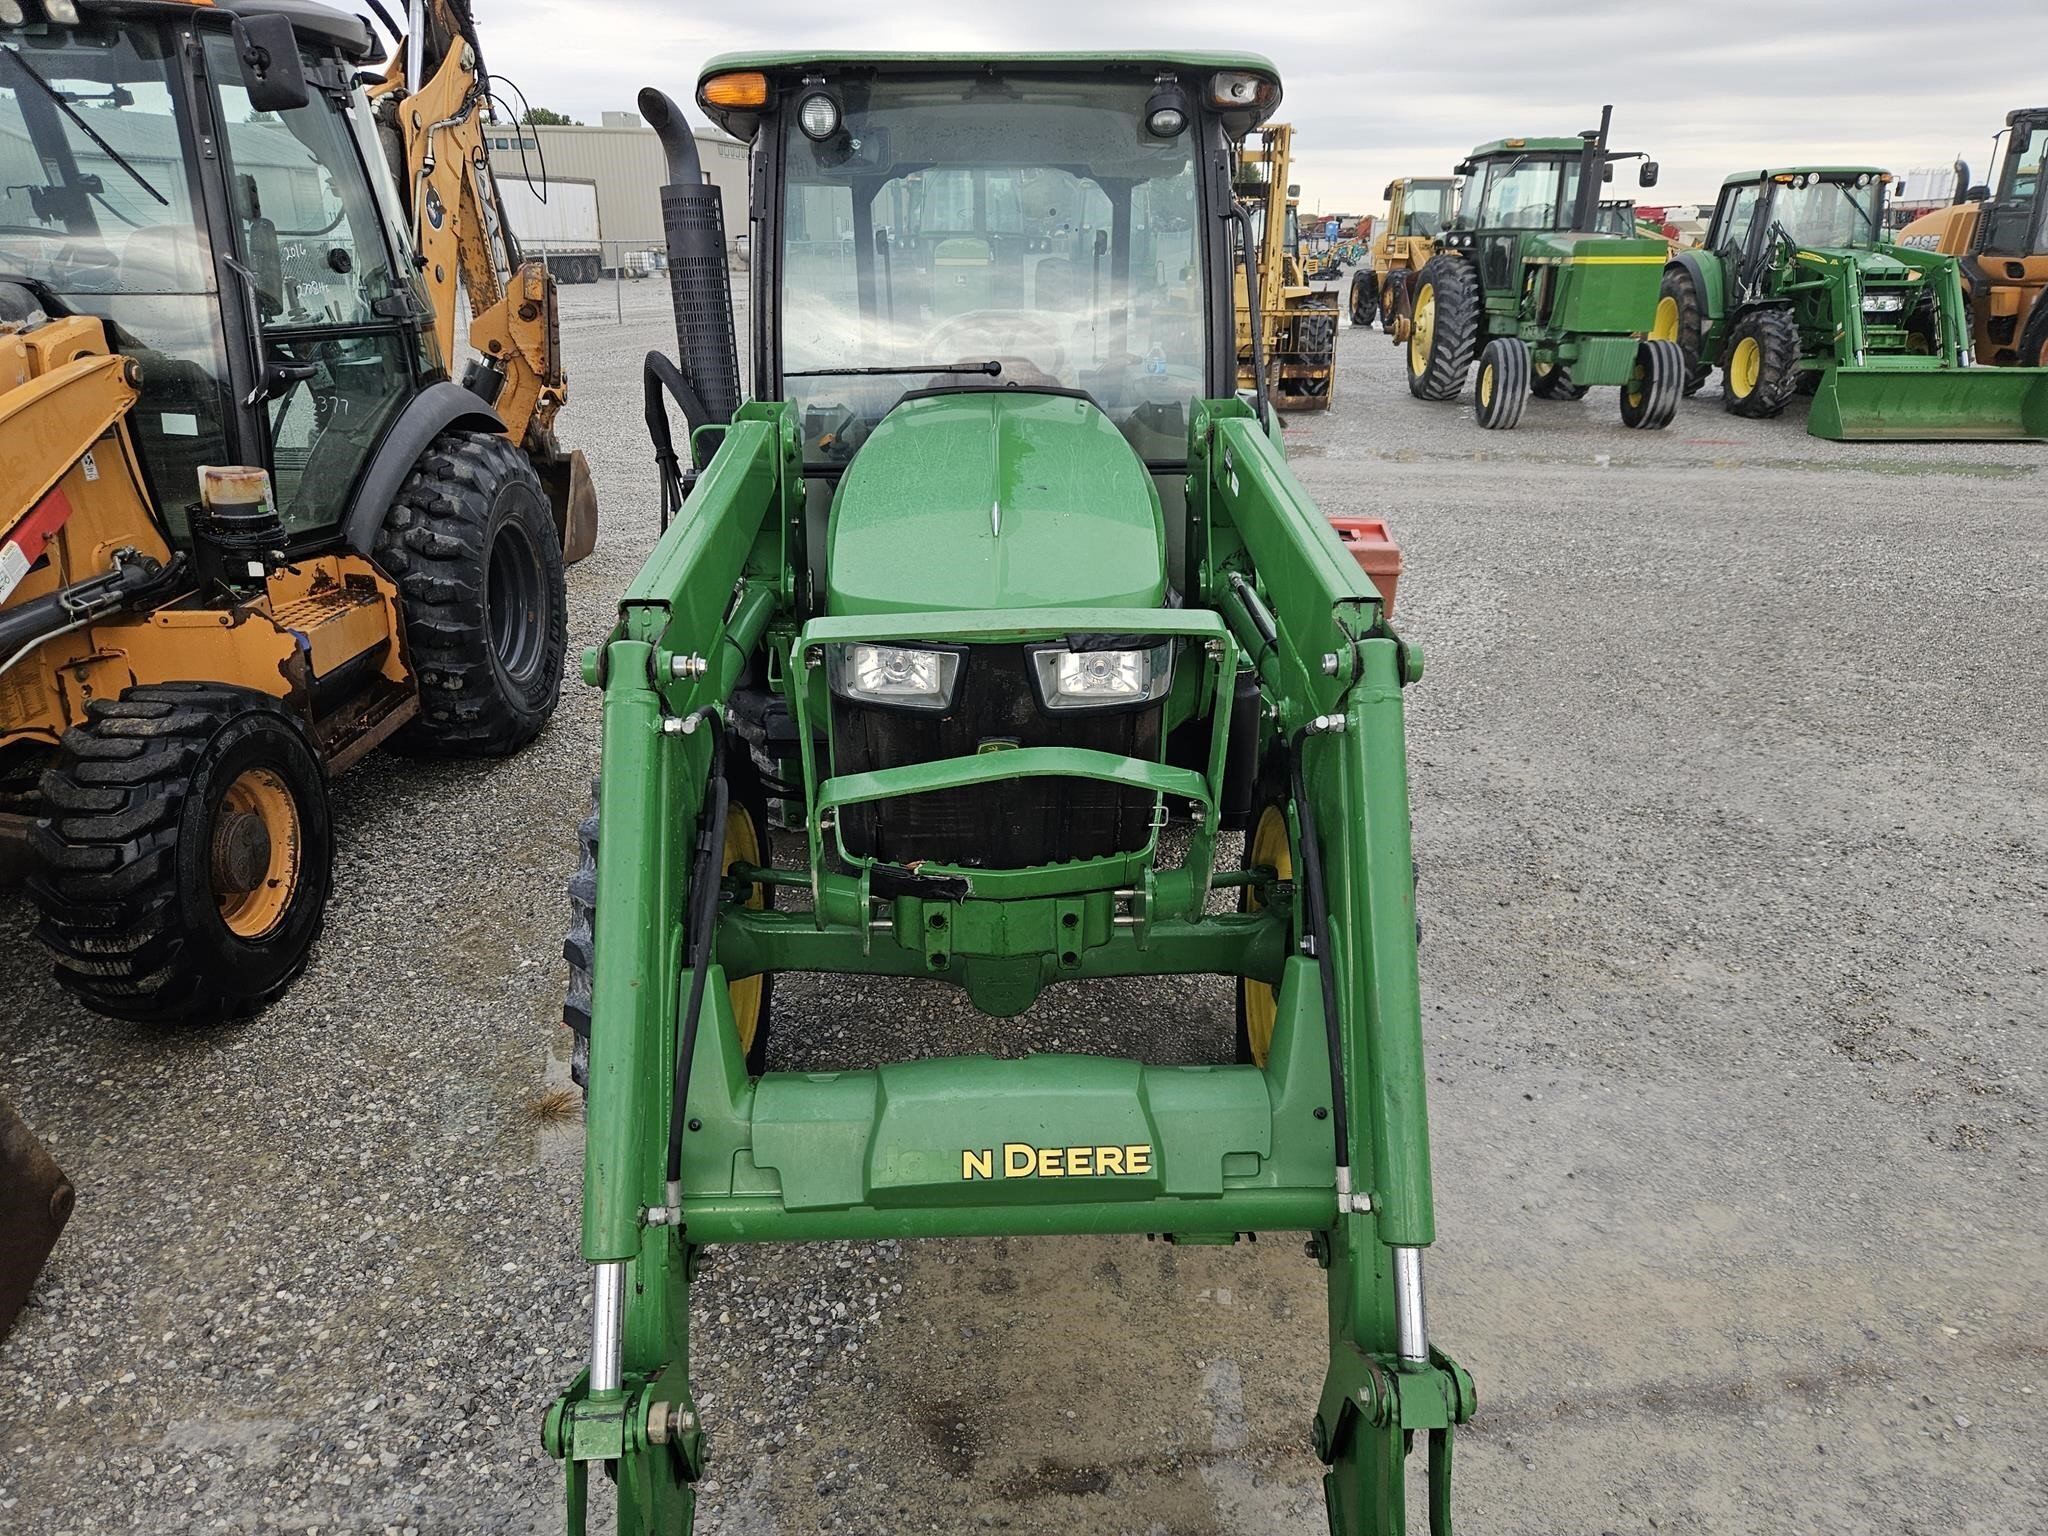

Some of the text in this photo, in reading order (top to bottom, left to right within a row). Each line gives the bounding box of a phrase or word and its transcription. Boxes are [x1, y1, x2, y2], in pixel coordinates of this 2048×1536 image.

[1903, 234, 1940, 251] CASE
[283, 244, 307, 261] 2016
[317, 395, 349, 417] 377
[1003, 1142, 1152, 1179] DEERE
